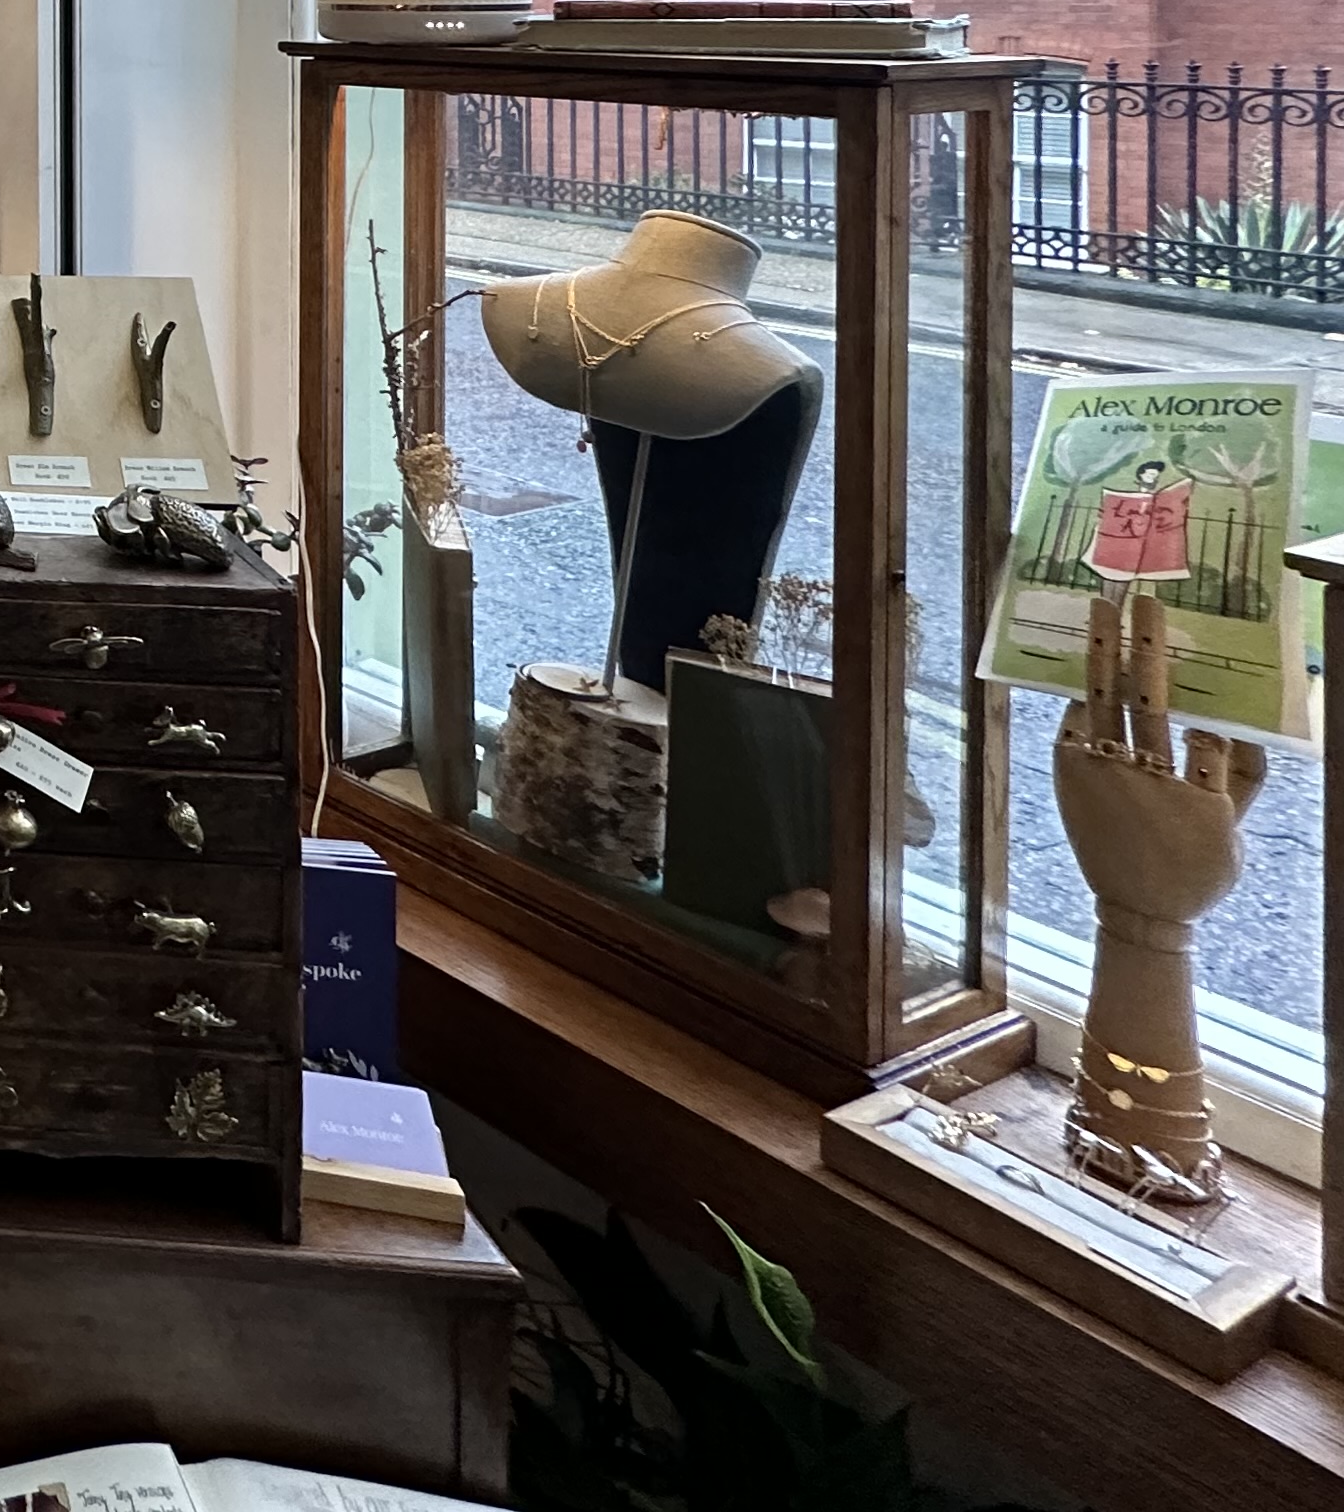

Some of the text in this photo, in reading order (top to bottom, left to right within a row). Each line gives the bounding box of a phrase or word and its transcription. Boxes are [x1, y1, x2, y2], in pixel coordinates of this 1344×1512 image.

[1068, 395, 1282, 419] Alex Monroe
[1112, 422, 1148, 436] guide
[1170, 422, 1227, 433] London
[302, 962, 362, 981] spoke
[320, 1120, 405, 1144] Alex Monroe
